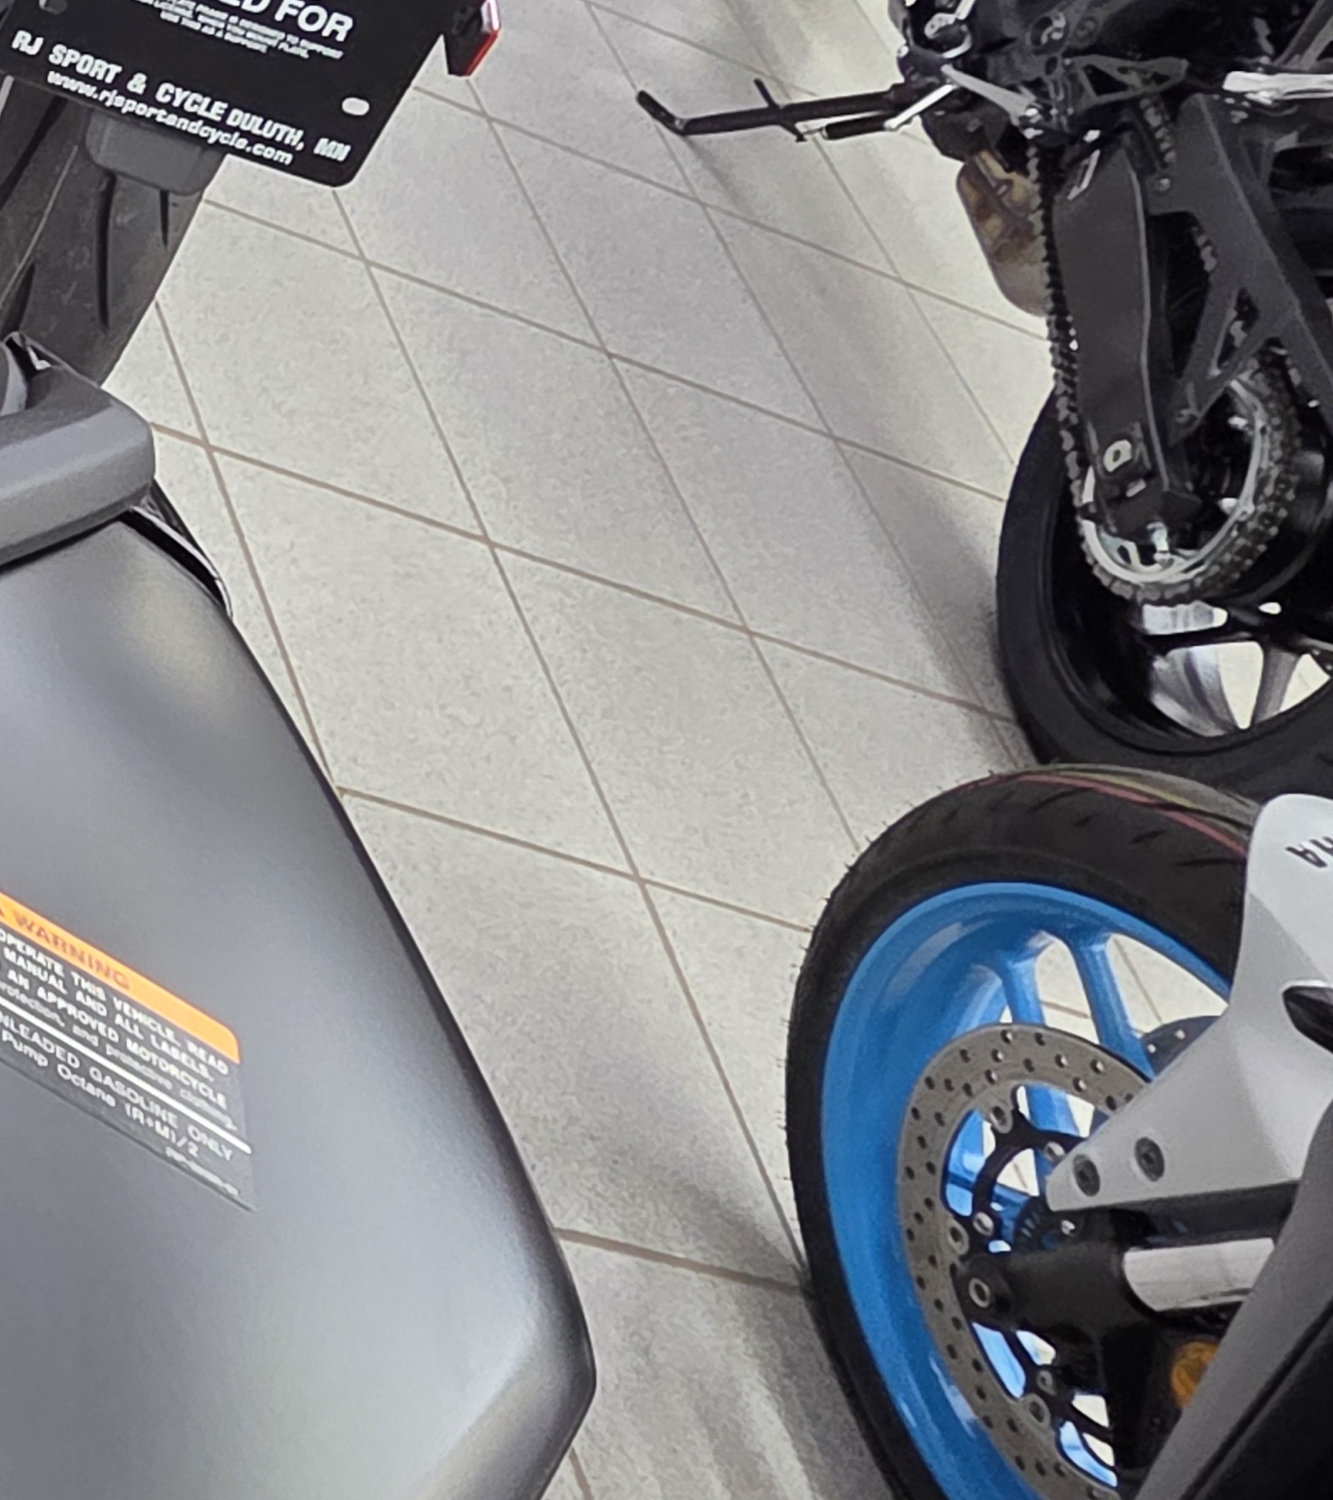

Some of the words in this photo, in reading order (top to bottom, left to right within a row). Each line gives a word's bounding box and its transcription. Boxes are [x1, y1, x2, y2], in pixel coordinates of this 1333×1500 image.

[11, 29, 44, 56] RJ
[48, 43, 122, 84] SPORT
[126, 71, 147, 94] &
[155, 82, 227, 122] CYCLE
[227, 107, 306, 152] DULUTH,
[313, 137, 352, 163] MN
[46, 71, 295, 166] www.rjsportandcycle.com
[4, 944, 67, 995] MANUAL
[75, 987, 106, 1018] AND
[114, 1011, 143, 1041] ALL
[14, 909, 131, 993] WARNING
[1, 1026, 47, 1070] Pump
[57, 1060, 115, 1110] Octane
[8, 966, 30, 991] AN
[37, 983, 118, 1046] APPROVED
[126, 1038, 226, 1110] MOTORCYCLE
[71, 971, 106, 1003] THIS
[187, 1040, 228, 1077] READ
[89, 1062, 177, 1130] GASOLINE
[187, 1122, 233, 1164] ONLY
